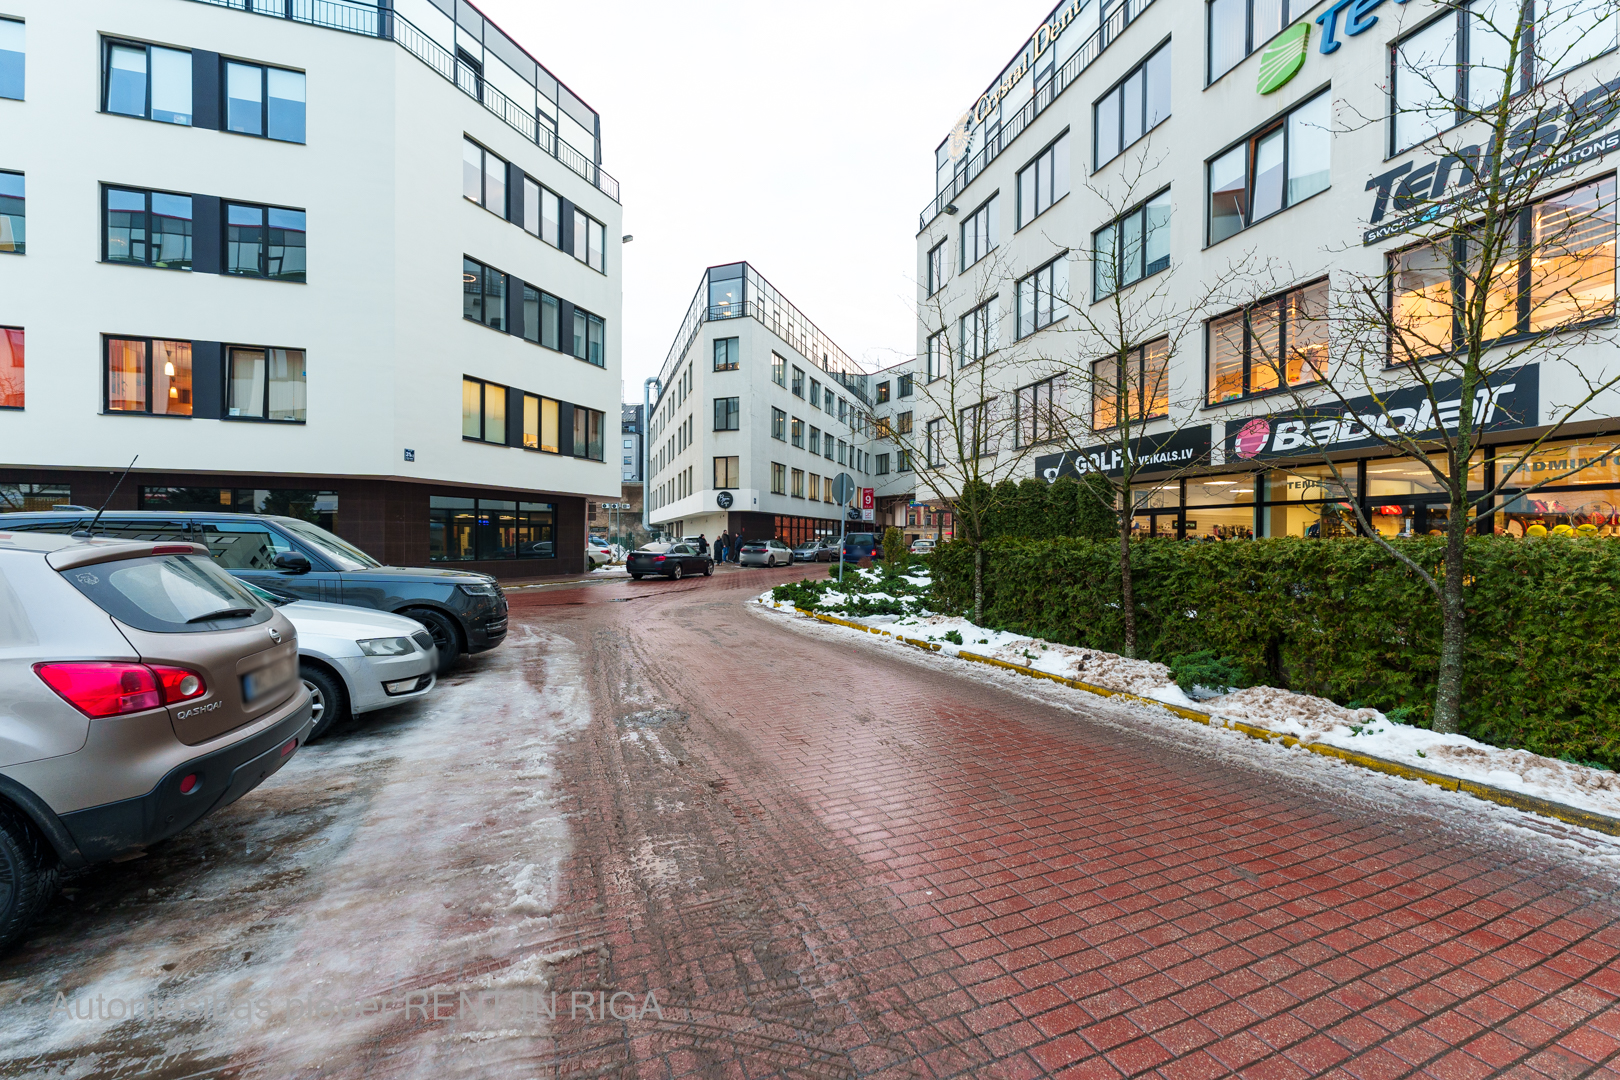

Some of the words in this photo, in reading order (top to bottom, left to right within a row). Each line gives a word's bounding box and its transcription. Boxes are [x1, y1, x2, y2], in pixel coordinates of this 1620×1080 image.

[973, 50, 1029, 125] Crystal
[865, 495, 872, 505] 9
[177, 700, 222, 720] QASHQAI
